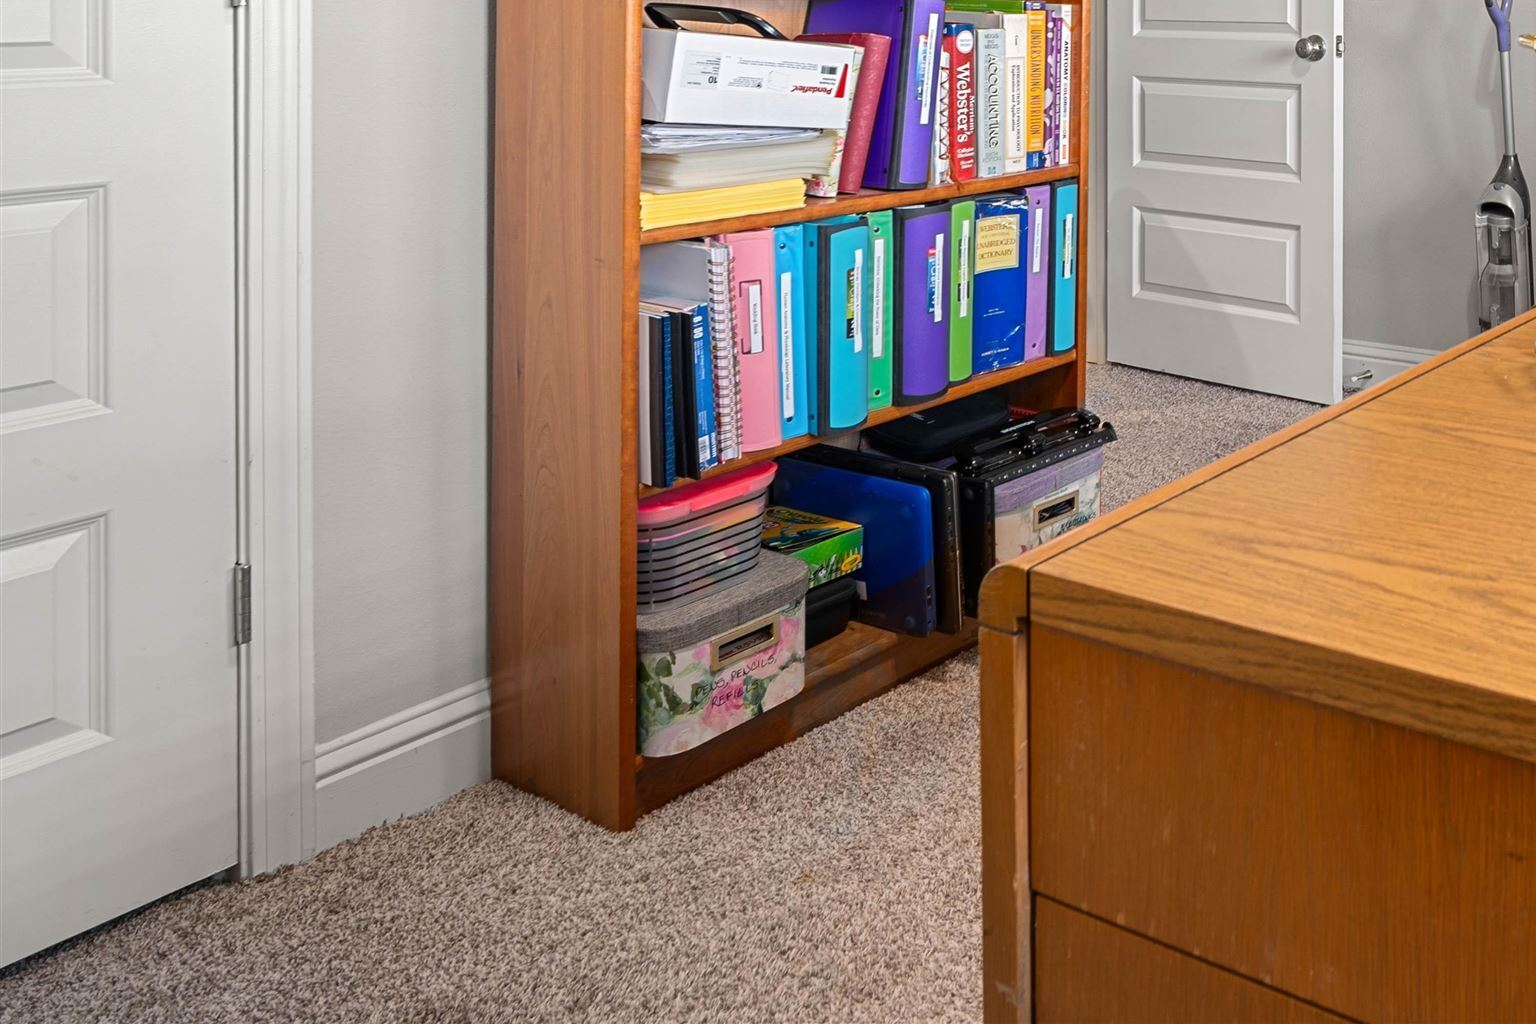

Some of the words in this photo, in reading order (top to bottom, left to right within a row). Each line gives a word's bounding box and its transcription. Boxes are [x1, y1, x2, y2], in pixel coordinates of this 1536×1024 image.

[708, 76, 718, 84] 10
[1030, 29, 1042, 92] UNDERSTANDING
[791, 85, 833, 95] Pendaflex
[955, 61, 971, 143] Webster's
[987, 53, 1001, 148] ACCOUNTING
[1030, 95, 1042, 136] NUTRITION
